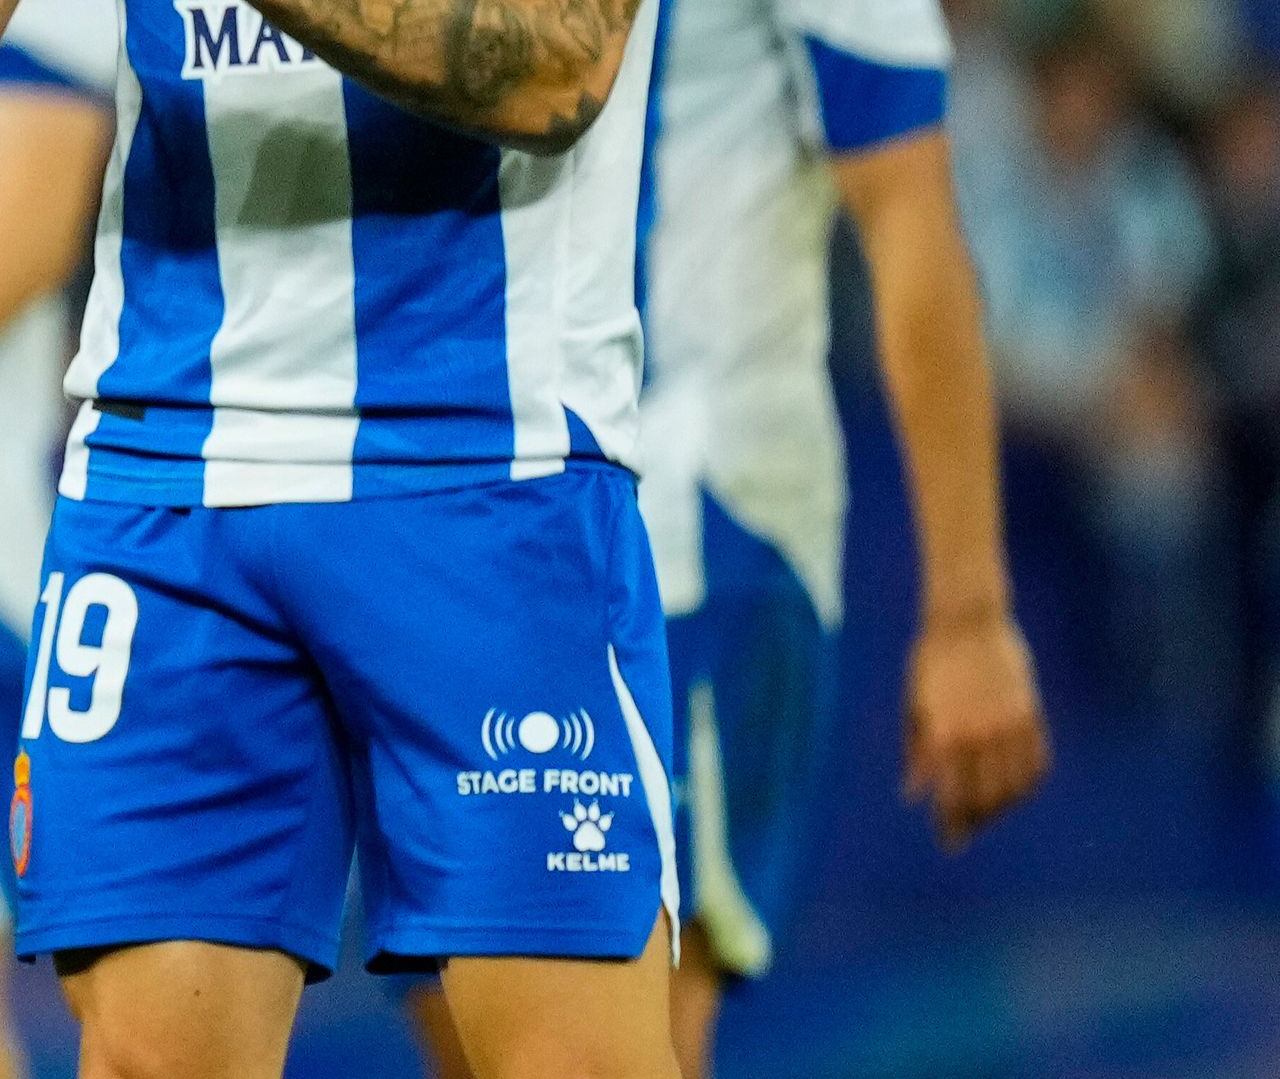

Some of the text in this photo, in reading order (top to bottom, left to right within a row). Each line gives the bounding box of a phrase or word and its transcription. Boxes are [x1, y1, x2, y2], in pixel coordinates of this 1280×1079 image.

[189, 6, 318, 71] MA
[21, 571, 139, 744] 19
[457, 768, 633, 797] STAGE FRONT
[546, 852, 631, 872] KELME
